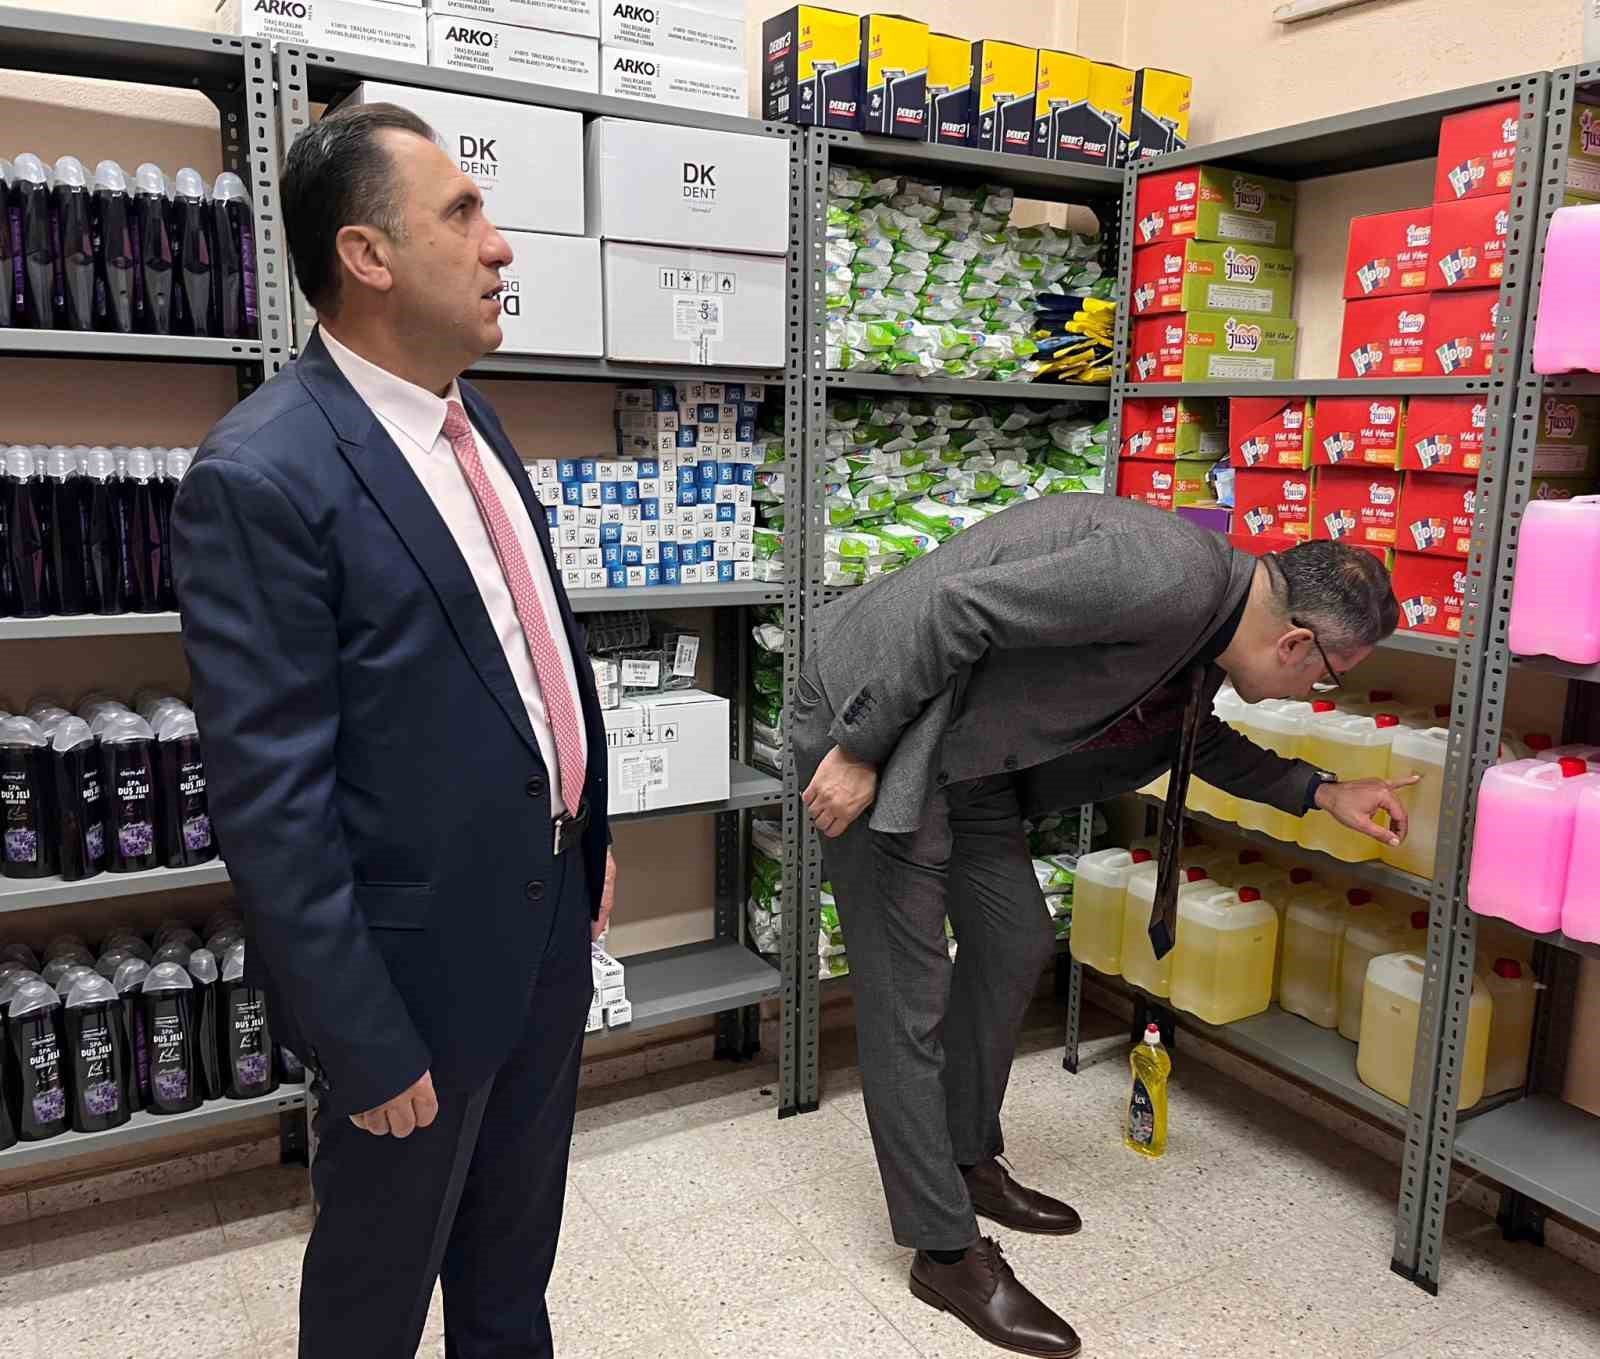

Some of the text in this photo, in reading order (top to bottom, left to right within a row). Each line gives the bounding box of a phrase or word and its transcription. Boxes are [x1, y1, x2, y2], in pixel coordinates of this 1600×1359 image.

[254, 0, 306, 18] ARKO
[613, 3, 655, 23] ARKO
[445, 26, 493, 47] ARKO
[613, 57, 655, 76] ARKO
[460, 135, 498, 162] DK
[461, 160, 499, 177] DENT
[683, 162, 716, 186] DK
[683, 186, 717, 199] DENT
[1200, 188, 1210, 200] 36
[1187, 262, 1197, 272] 36
[1227, 259, 1256, 281] jussy
[1187, 333, 1198, 344] 36
[1228, 330, 1257, 351] jussy
